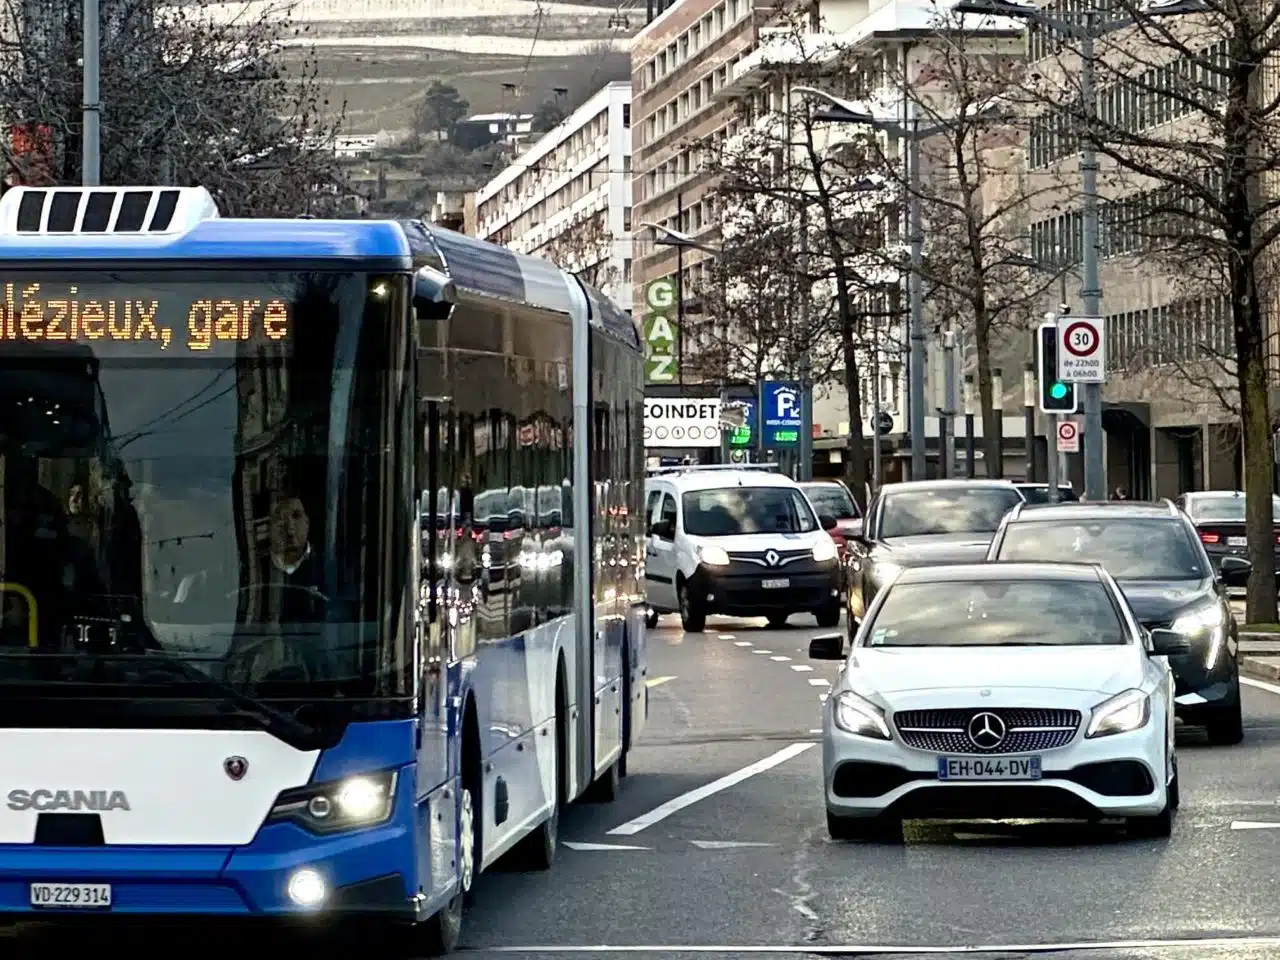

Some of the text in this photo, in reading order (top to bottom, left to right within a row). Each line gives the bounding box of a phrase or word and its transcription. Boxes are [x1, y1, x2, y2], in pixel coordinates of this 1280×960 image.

[187, 300, 288, 350] gare
[647, 280, 675, 381] GAZ
[1074, 333, 1090, 346] 30
[1063, 359, 1100, 368] de 22h00
[948, 760, 1030, 776] EH-044-DV
[6, 788, 132, 811] SCANIA
